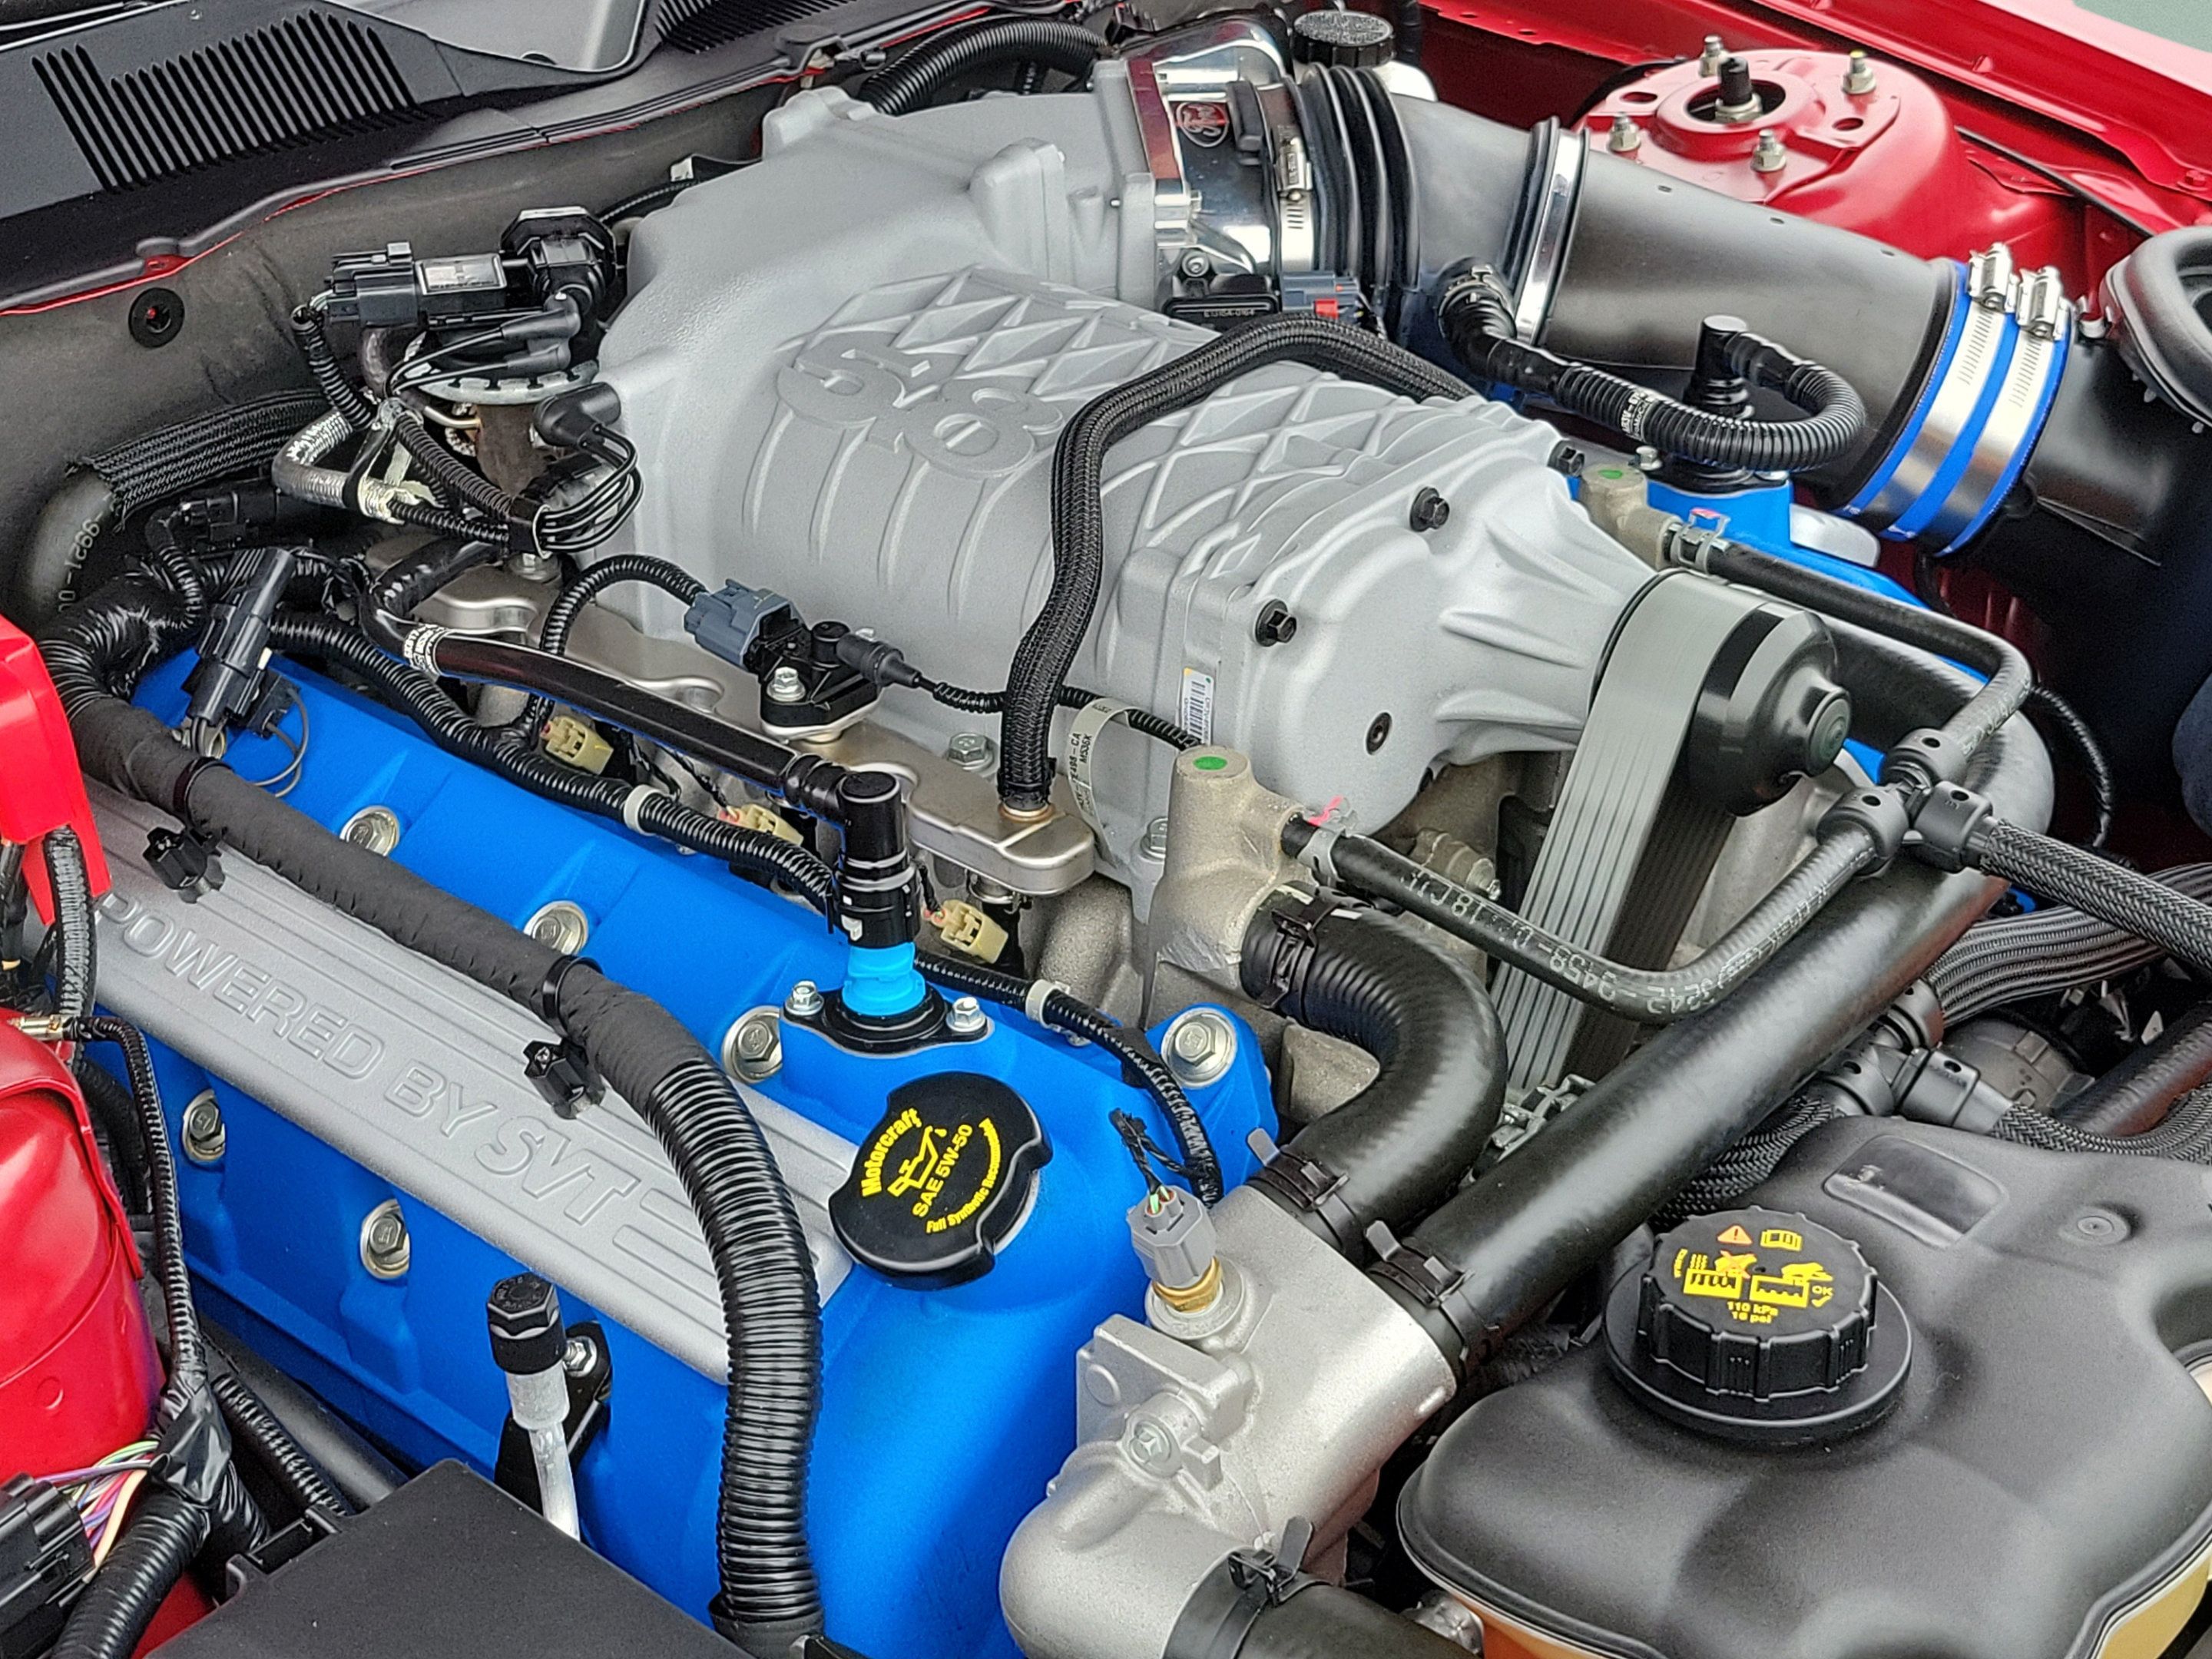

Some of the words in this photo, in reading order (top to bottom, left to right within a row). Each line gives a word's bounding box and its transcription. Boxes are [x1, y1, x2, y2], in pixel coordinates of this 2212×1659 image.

[94, 892, 386, 1080] POWERED
[383, 1065, 498, 1139] BY
[472, 1115, 643, 1227] SVT
[860, 1108, 922, 1197] Motorcraft
[911, 1177, 945, 1217] SAE
[935, 1124, 973, 1178] 5W-50
[926, 1217, 948, 1233] Full
[1727, 1301, 1751, 1312] 110
[1753, 1303, 1779, 1317] kPa
[1811, 1284, 1834, 1297] OK
